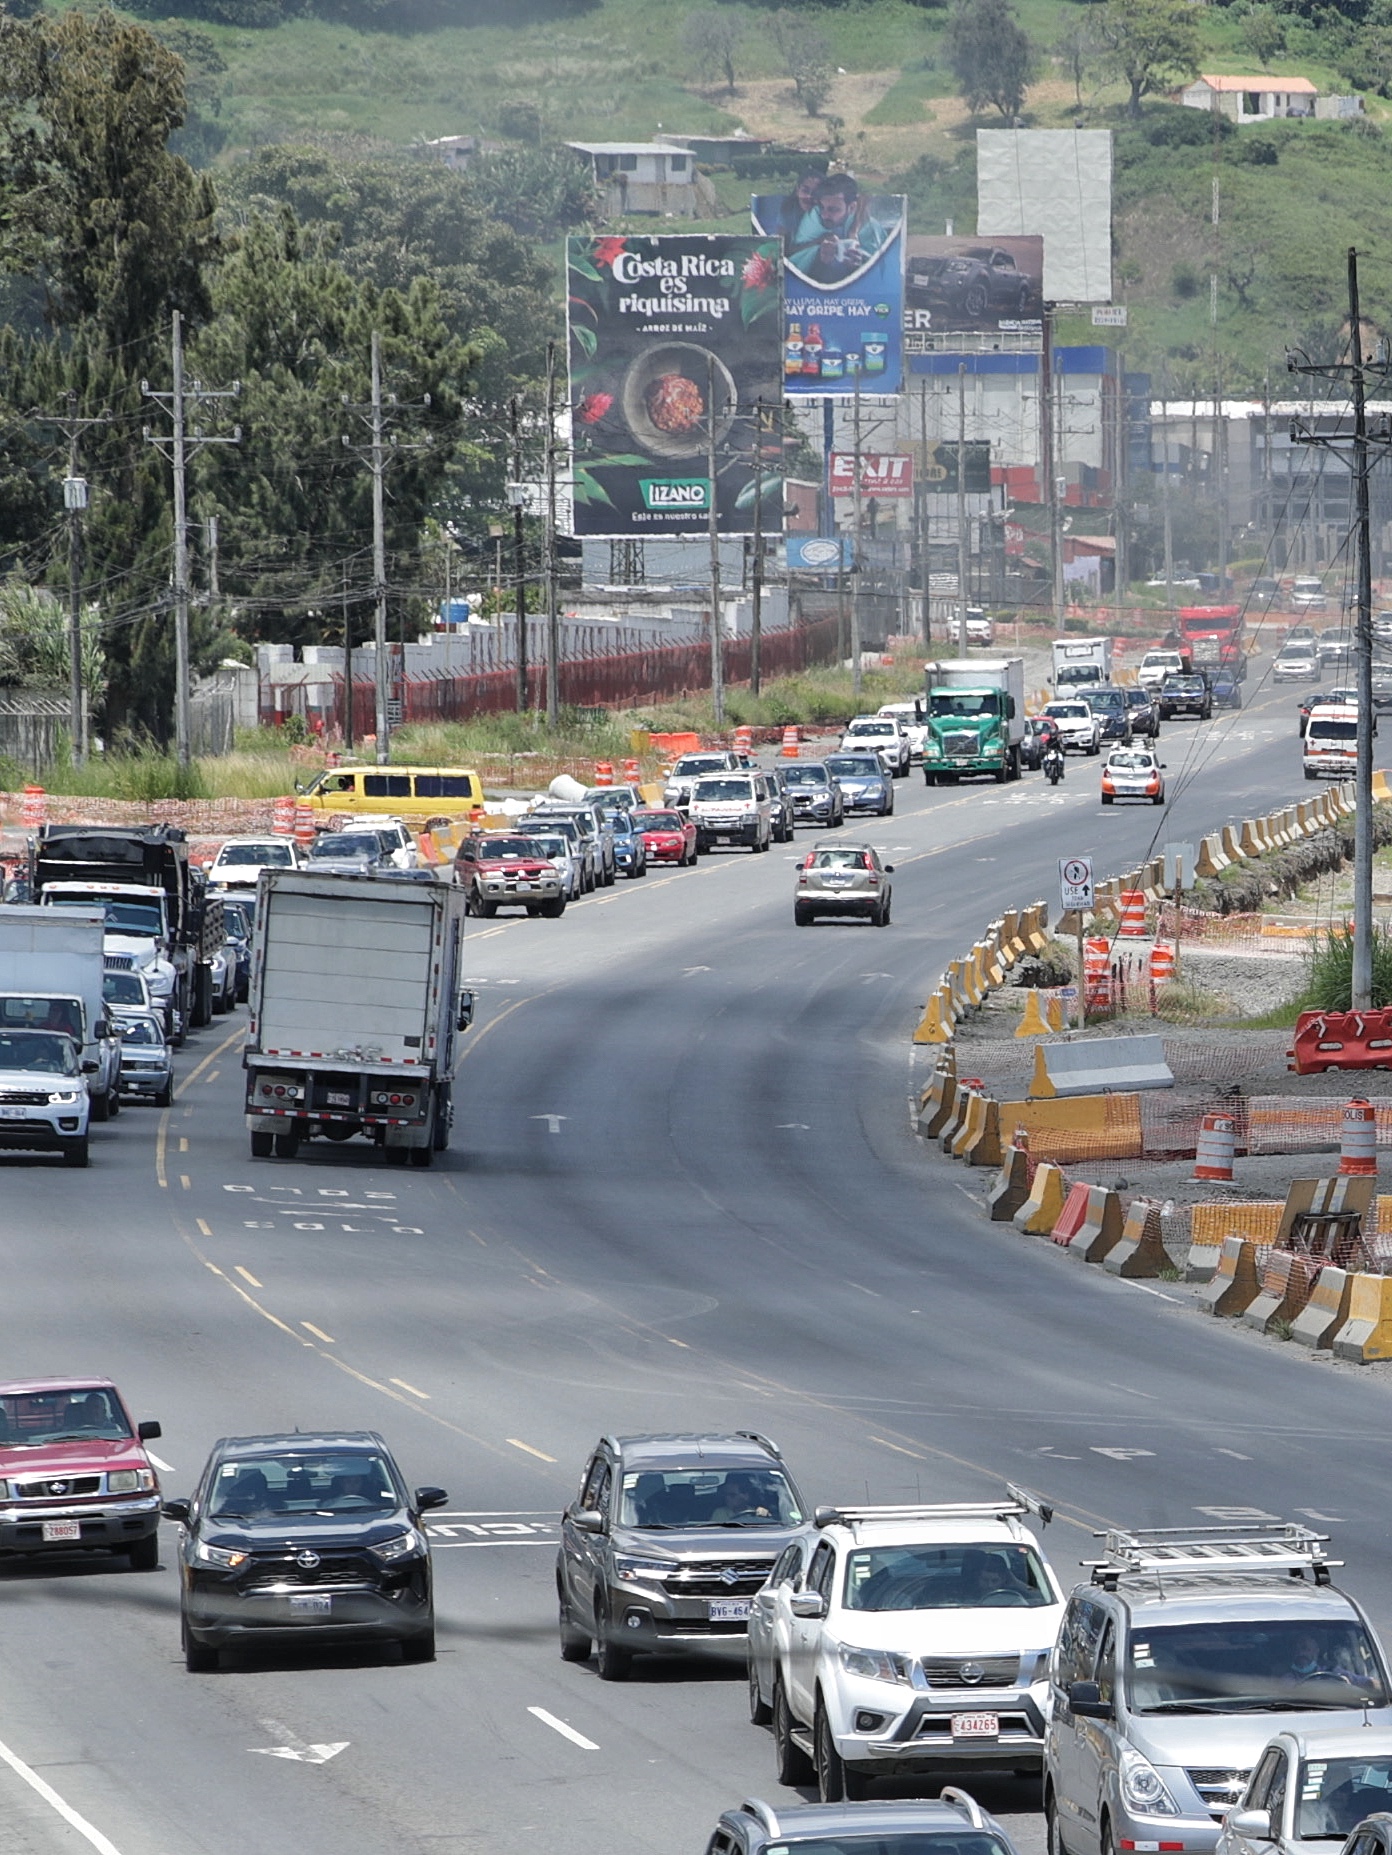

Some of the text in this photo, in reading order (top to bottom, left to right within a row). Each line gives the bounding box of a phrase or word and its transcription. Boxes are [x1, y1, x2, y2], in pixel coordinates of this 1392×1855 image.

[612, 252, 735, 284] Costa Rica
[660, 276, 688, 294] es
[619, 293, 730, 319] riquísima
[848, 305, 872, 316] HAY
[642, 324, 670, 332] ARROZ
[671, 324, 683, 332] DE
[650, 484, 705, 505] LIZANO
[698, 512, 723, 521] sar
[1064, 886, 1079, 896] USE
[960, 1719, 997, 1731] 434265
